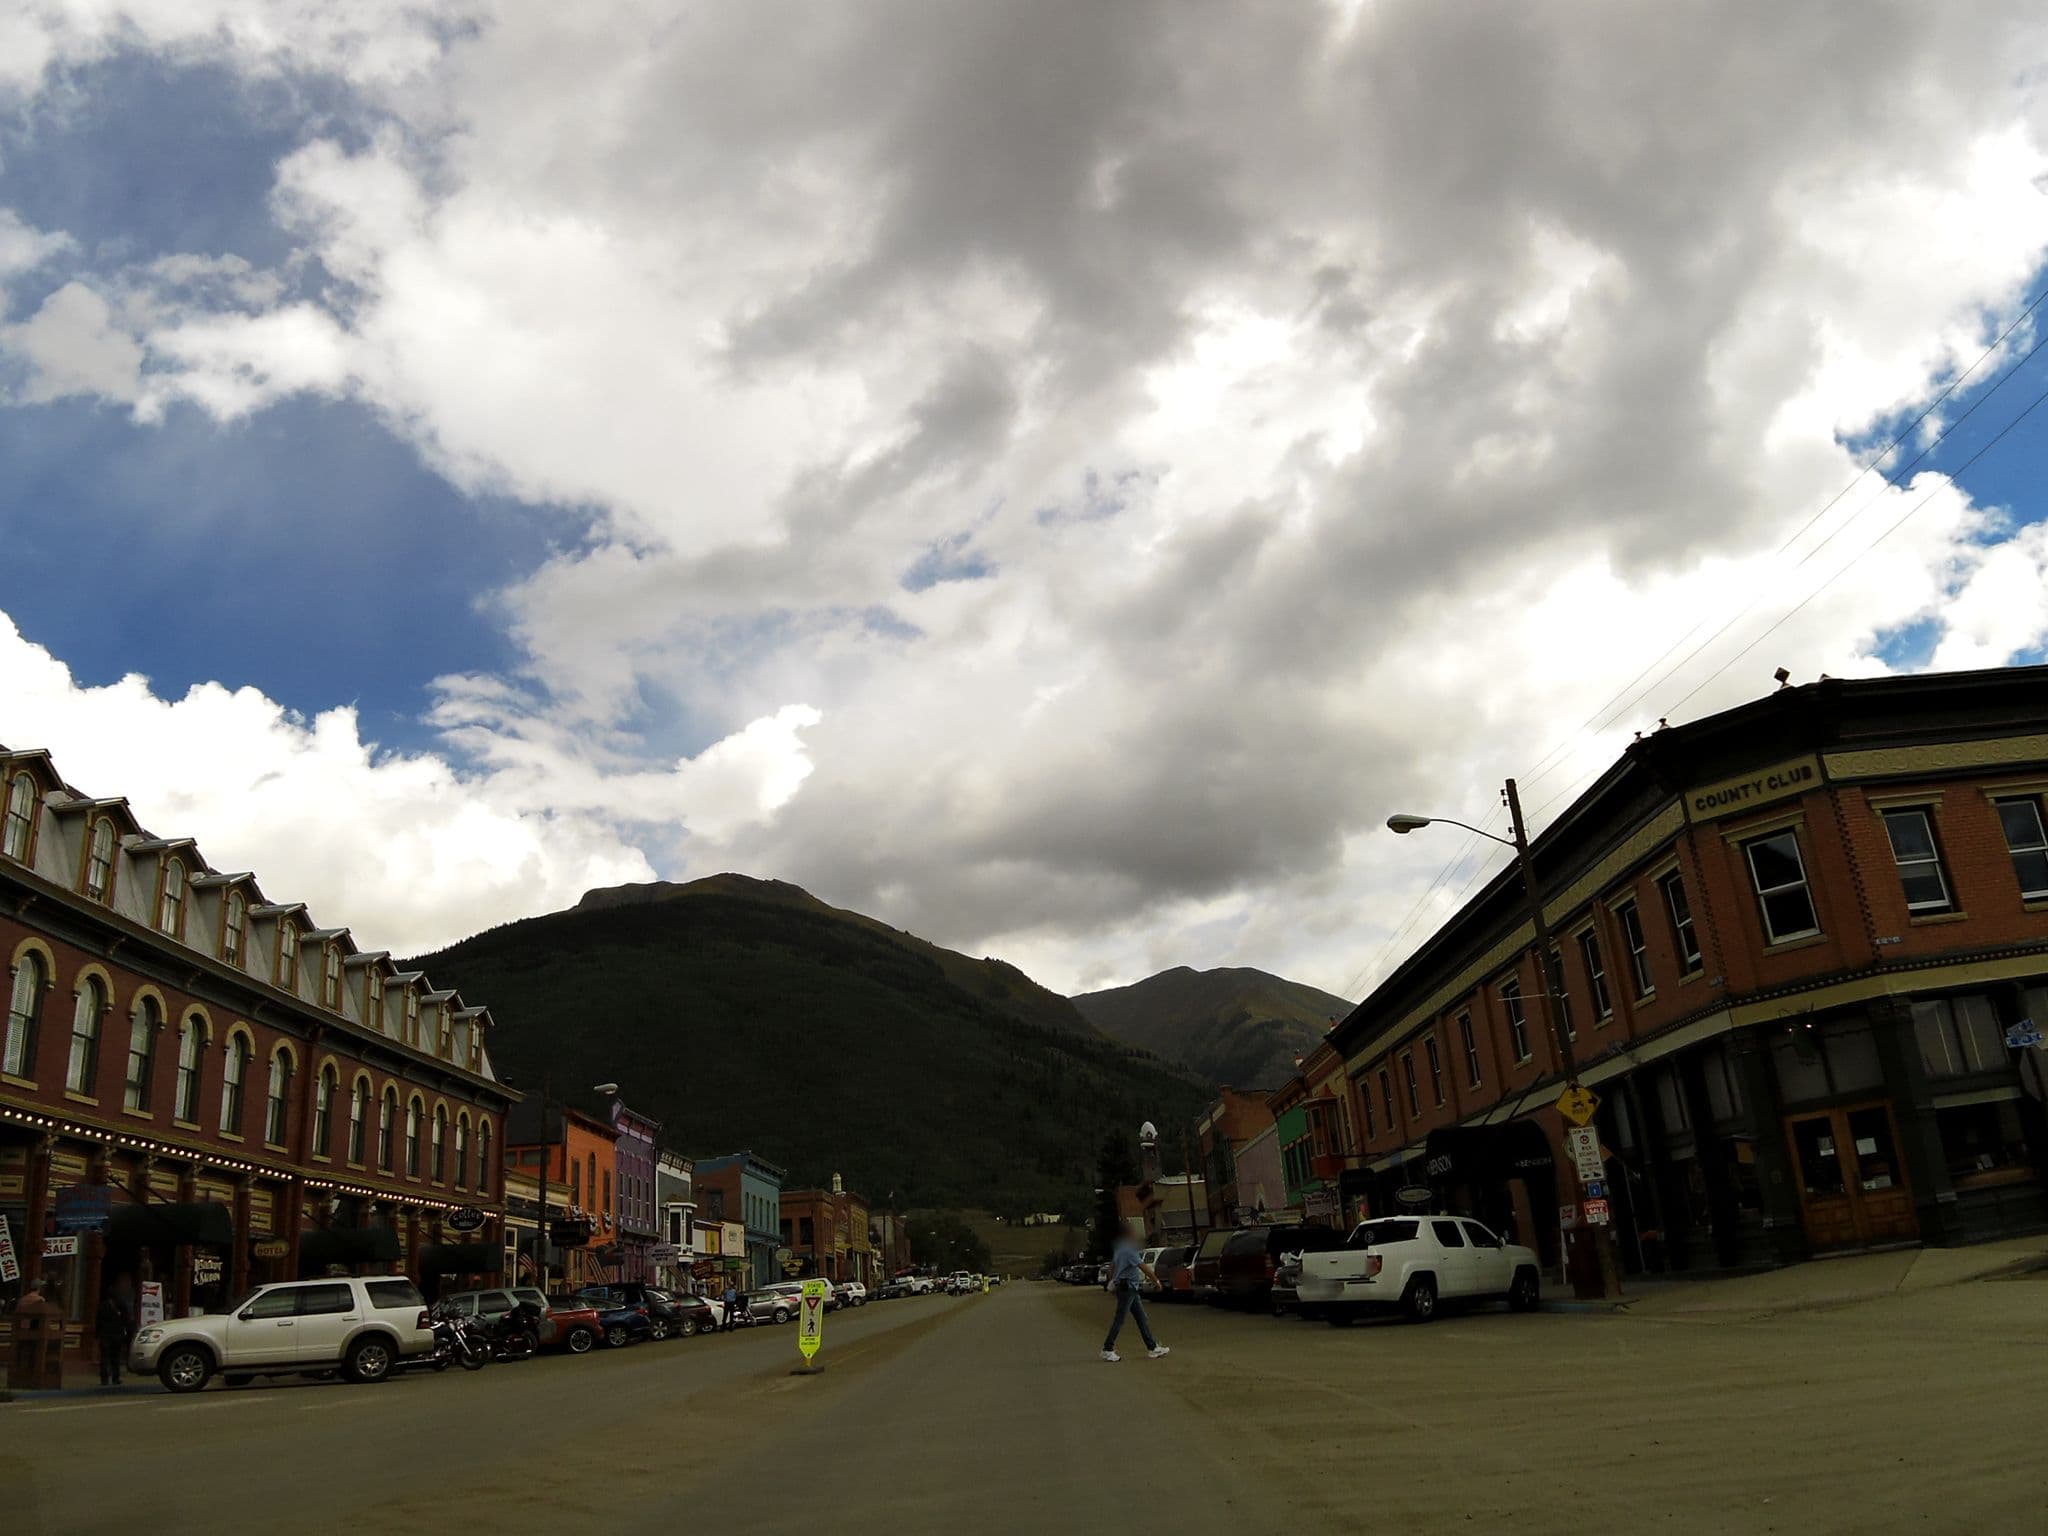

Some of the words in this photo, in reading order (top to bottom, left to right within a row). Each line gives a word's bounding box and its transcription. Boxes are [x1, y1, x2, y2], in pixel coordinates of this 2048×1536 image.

[1695, 779, 1763, 811] COUNTY
[1767, 765, 1812, 790] CLUB
[46, 1243, 73, 1254] SALE
[257, 1247, 283, 1255] HOTEL
